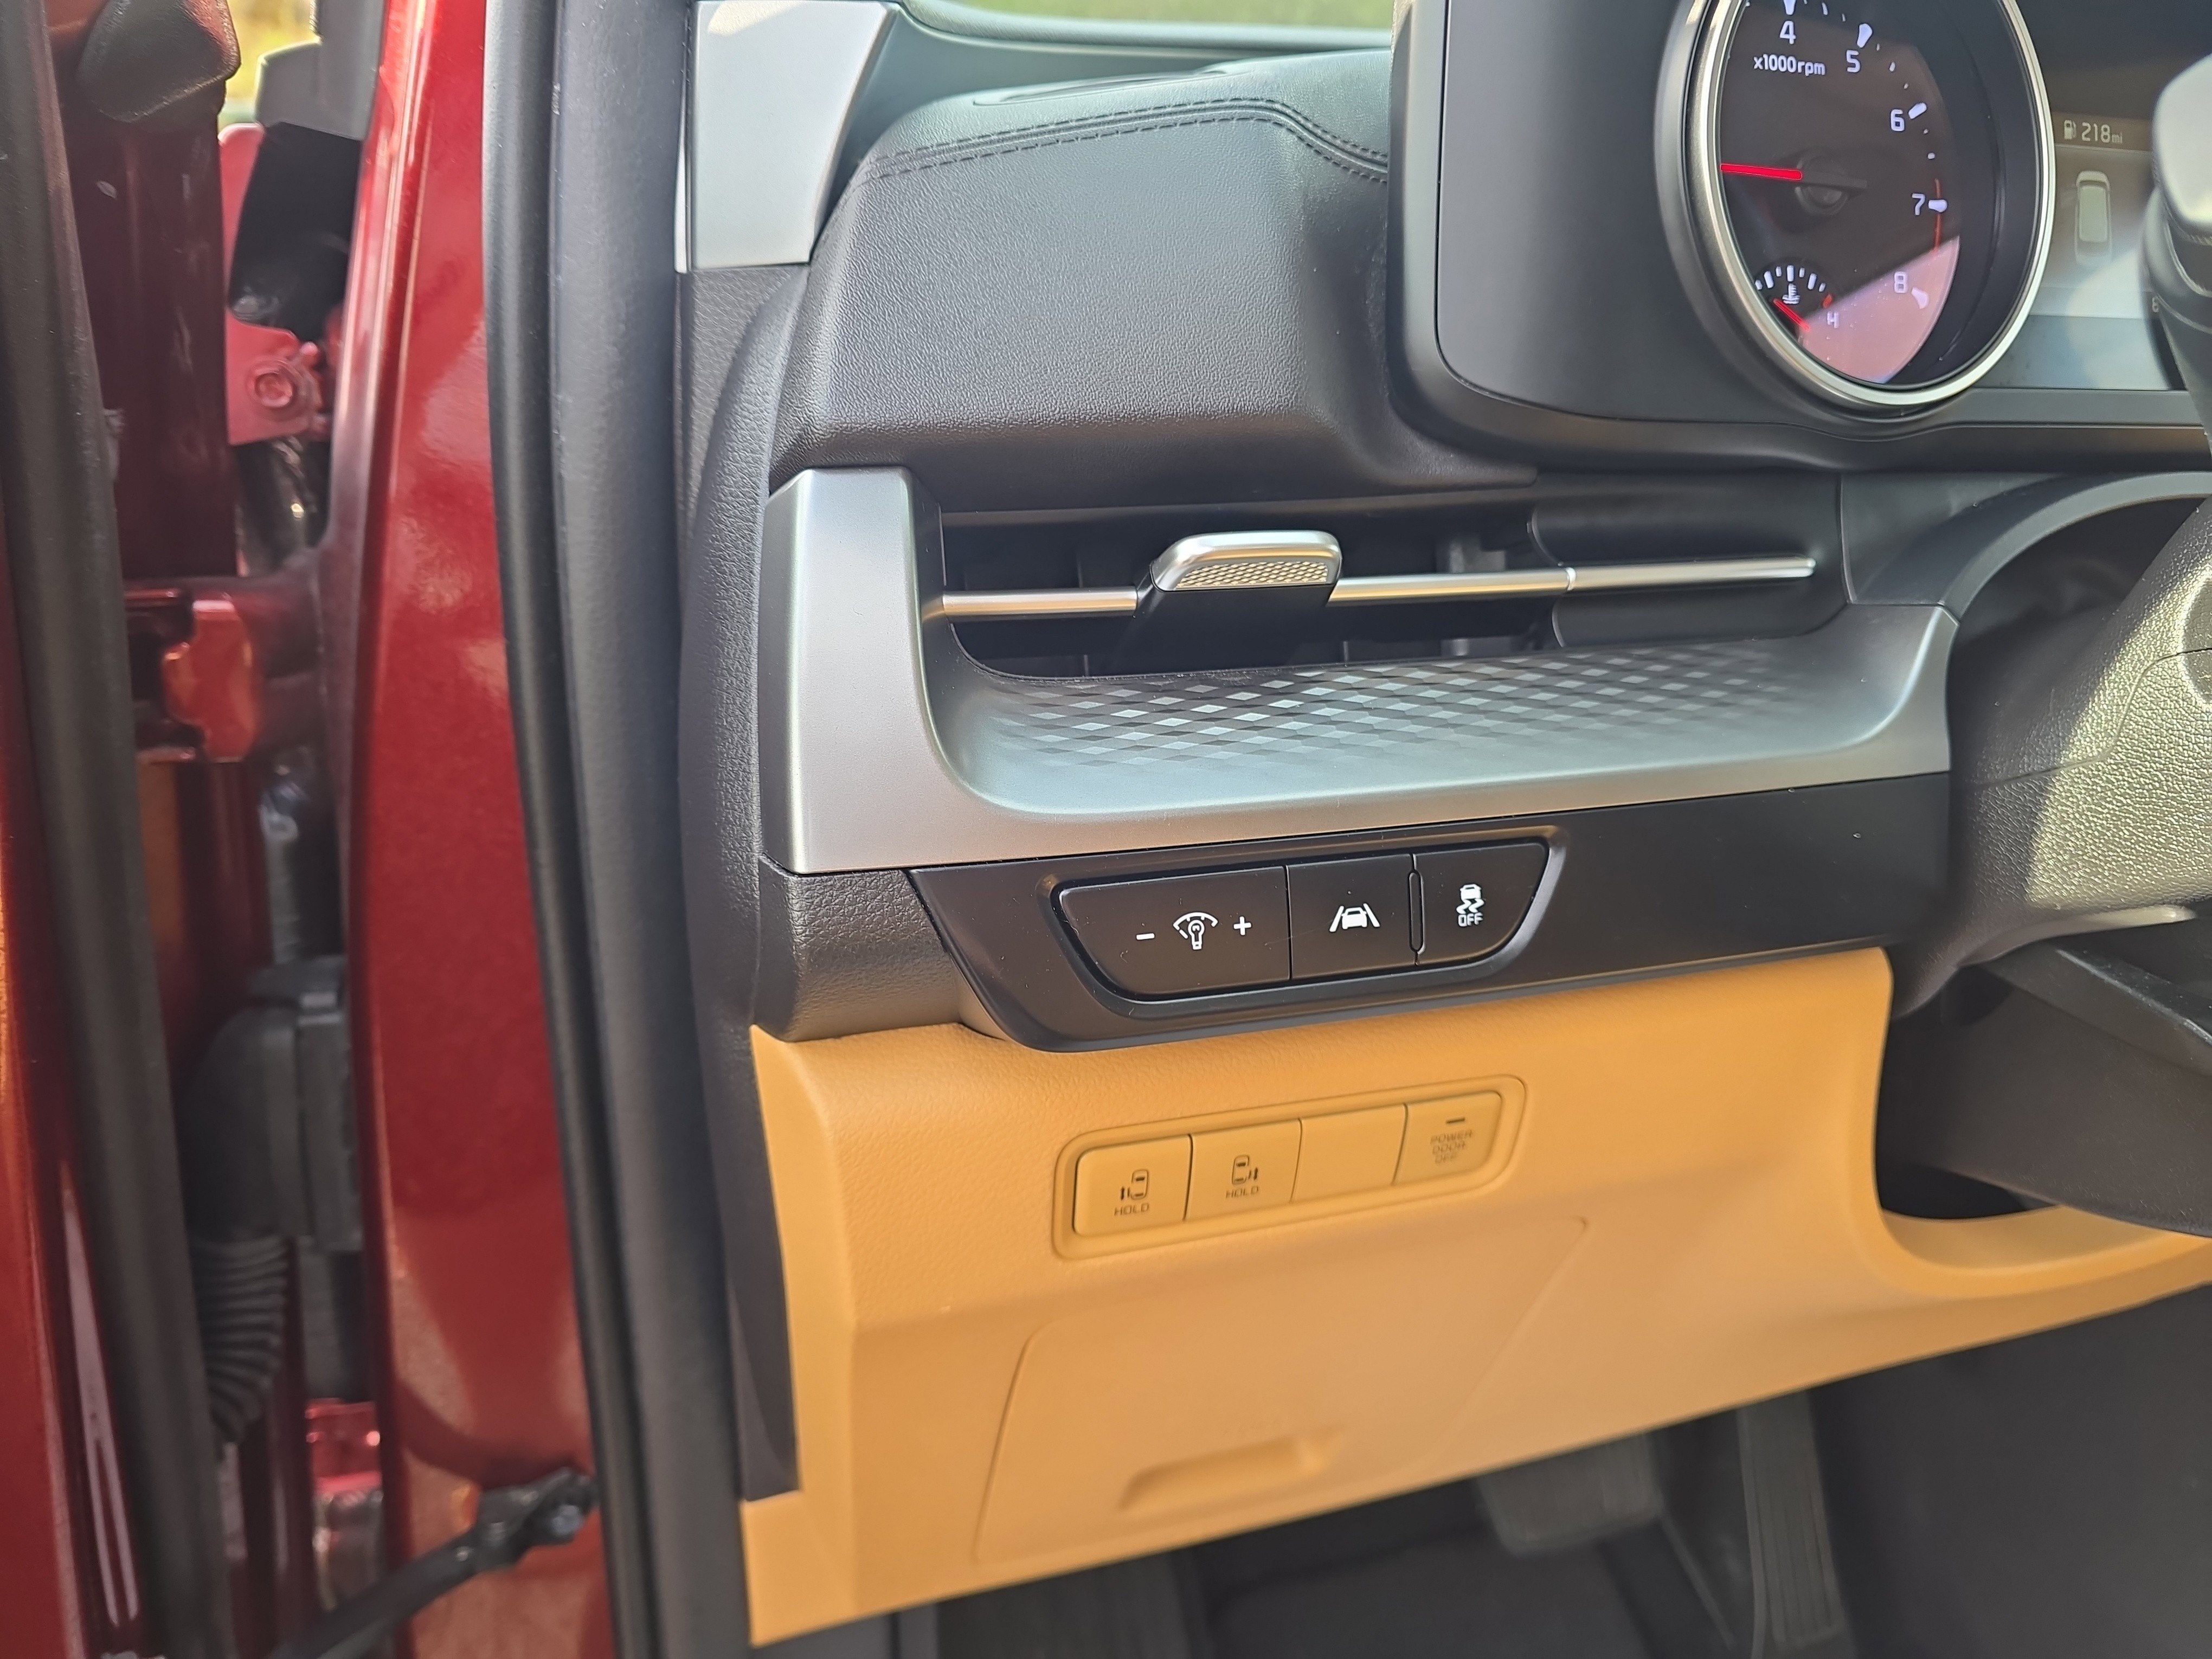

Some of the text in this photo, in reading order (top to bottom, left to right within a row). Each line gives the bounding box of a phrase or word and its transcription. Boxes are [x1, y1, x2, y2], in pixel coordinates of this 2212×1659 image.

[1779, 20, 1797, 45] 4
[1846, 49, 1861, 73] 5
[1890, 108, 1905, 132] 6
[1911, 192, 1926, 216] 7
[1894, 271, 1908, 294] 8
[1827, 310, 1840, 329] H
[1457, 912, 1484, 927] OFF
[1225, 1185, 1259, 1199] HOLD
[1114, 1203, 1150, 1216] HOLD
